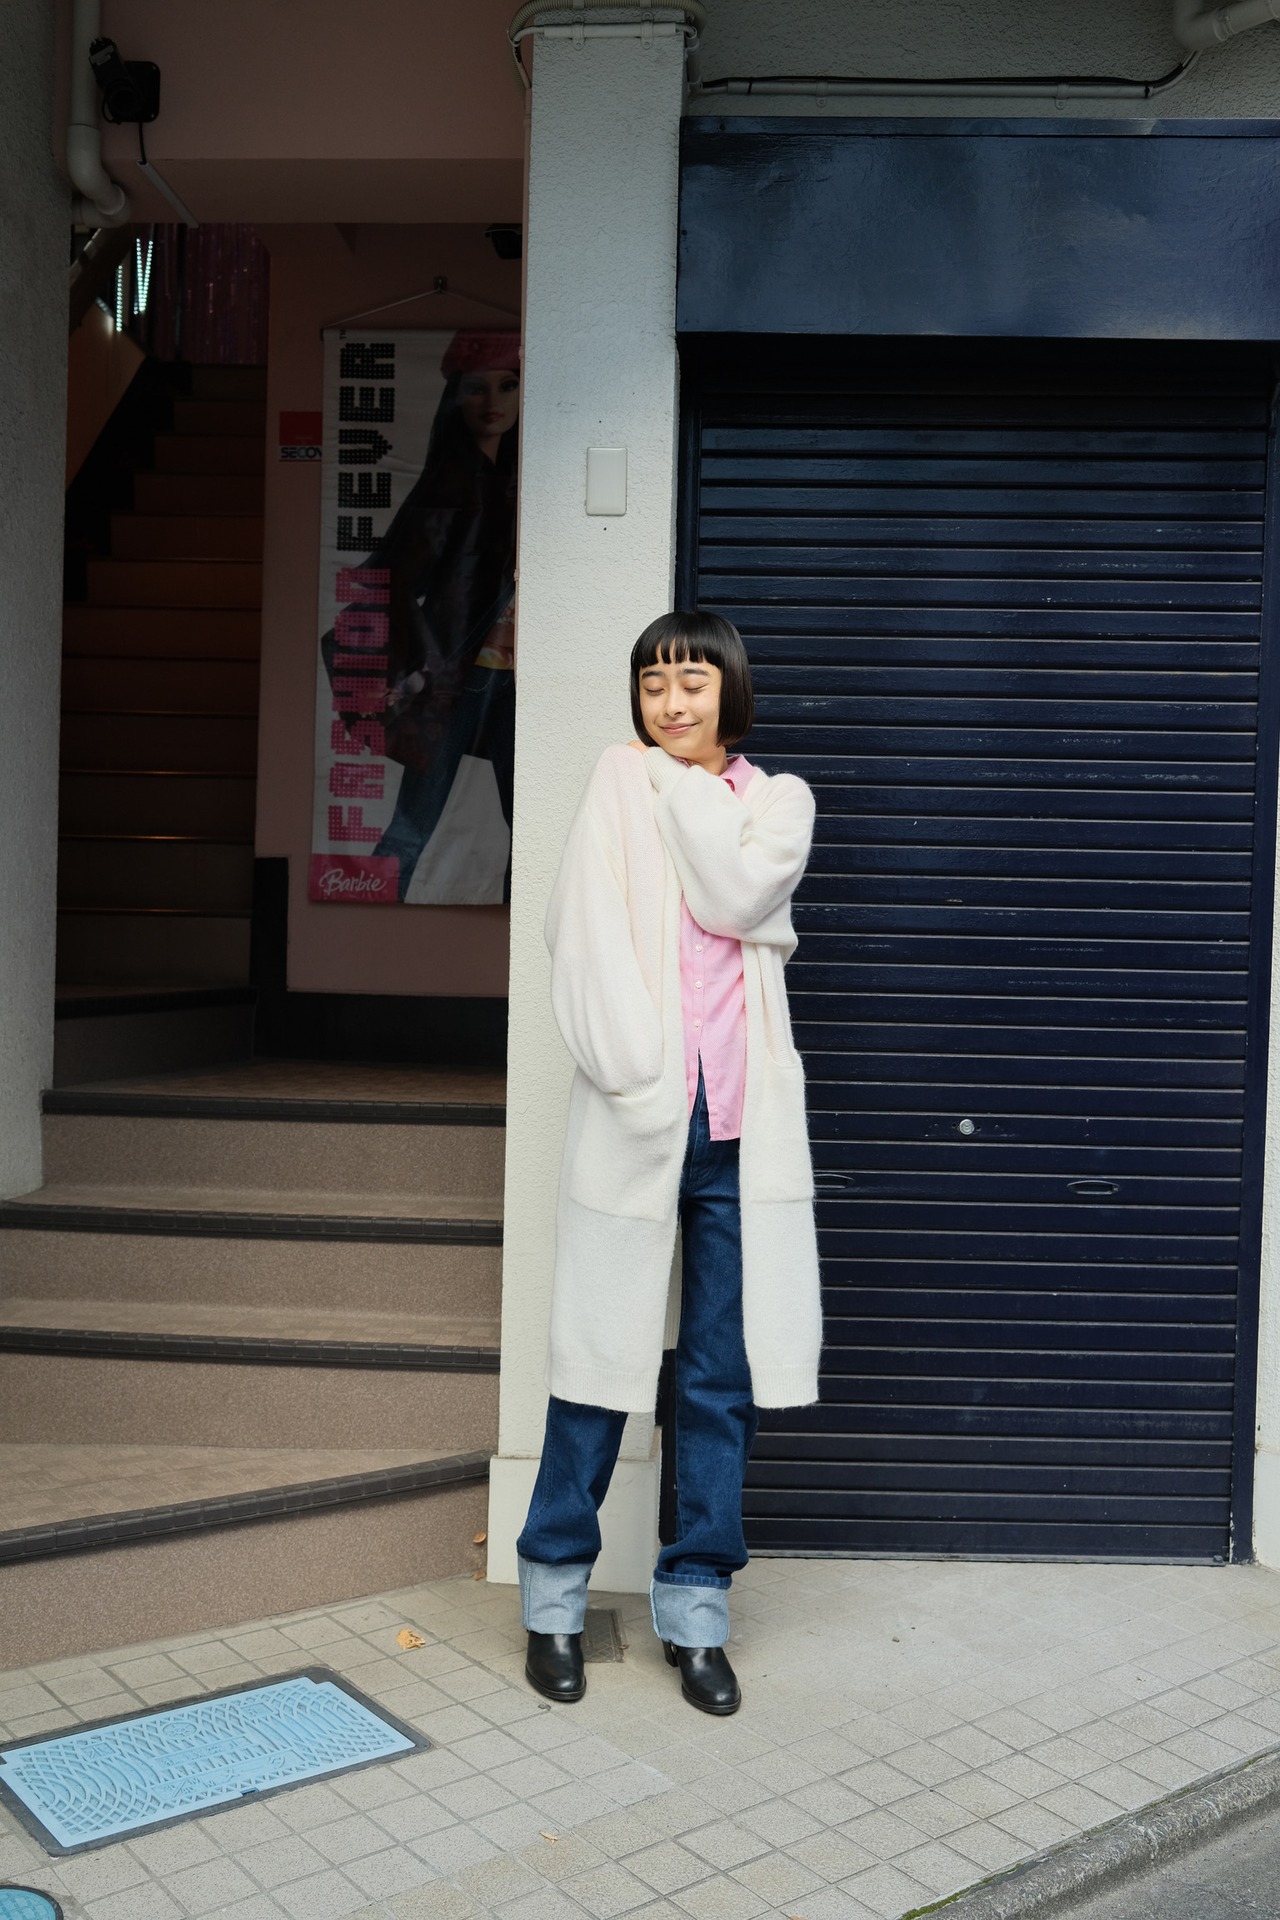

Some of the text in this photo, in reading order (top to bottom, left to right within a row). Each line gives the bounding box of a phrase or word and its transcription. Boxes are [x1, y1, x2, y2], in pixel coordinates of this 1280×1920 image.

[336, 343, 395, 552] FEVER
[328, 567, 393, 844] FASHION
[319, 867, 388, 895] Barbie
